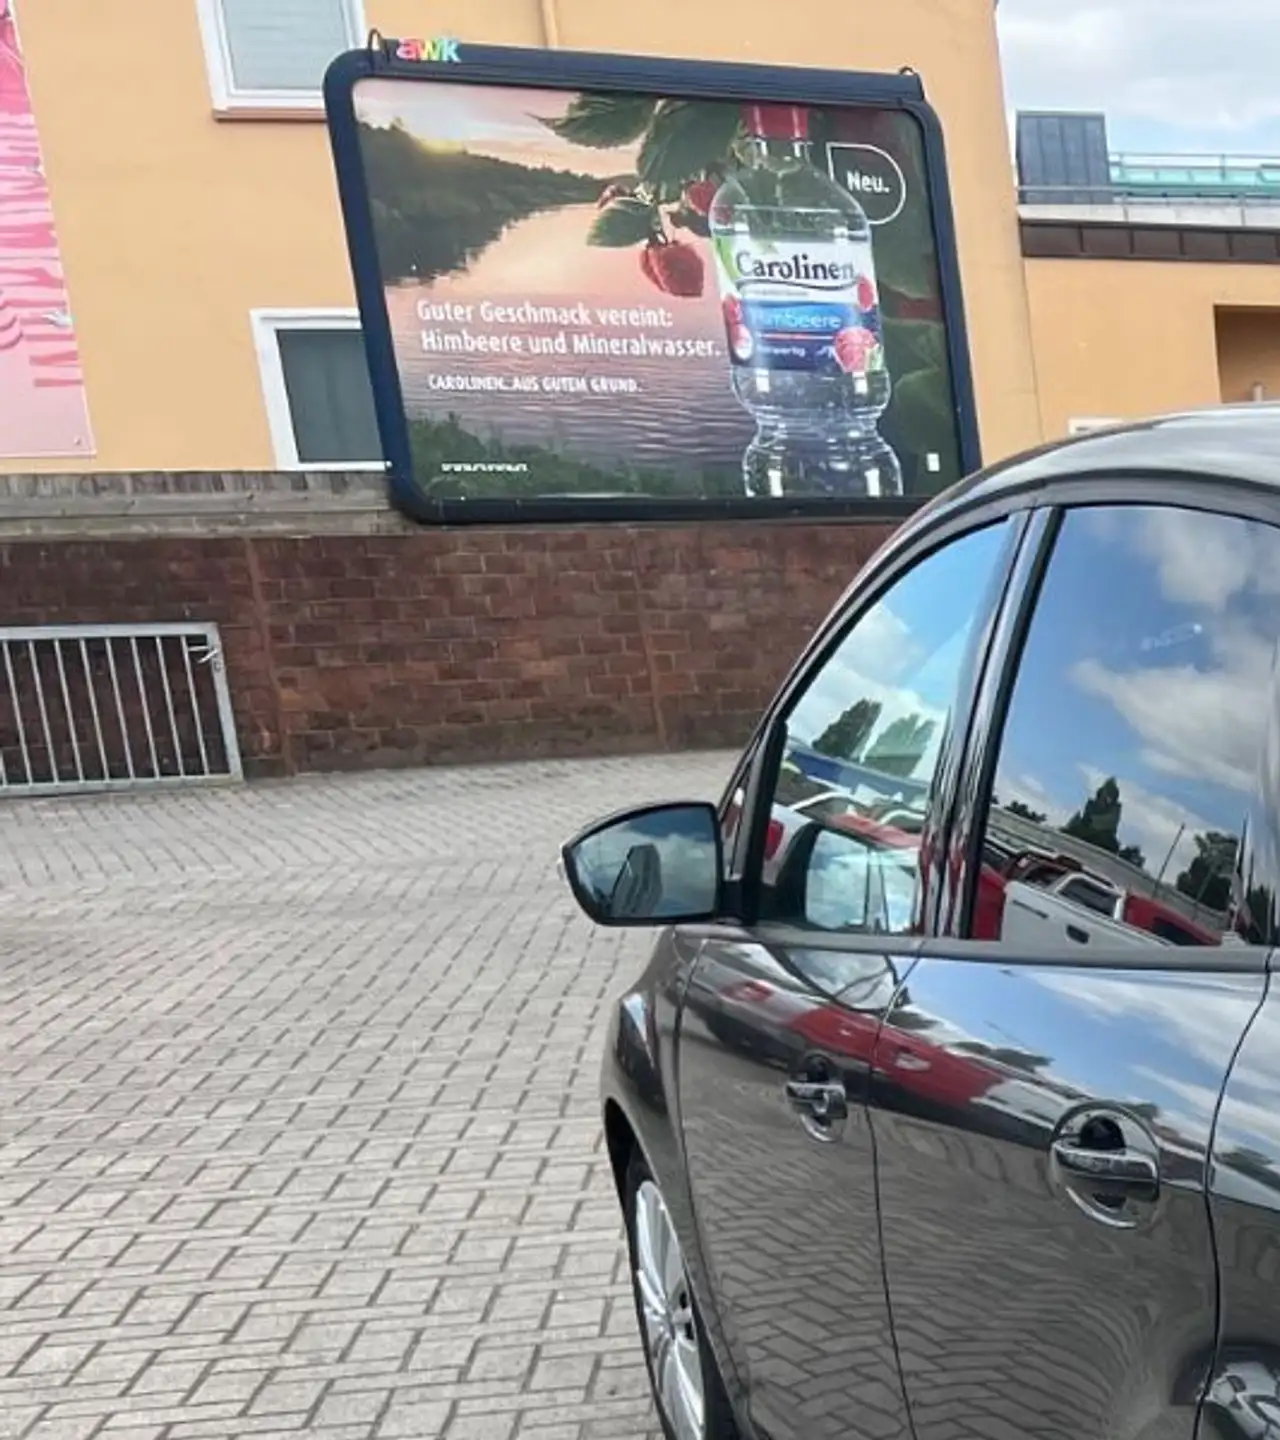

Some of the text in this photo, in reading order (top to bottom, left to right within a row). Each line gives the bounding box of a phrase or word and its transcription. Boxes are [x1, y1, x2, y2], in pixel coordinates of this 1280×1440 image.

[396, 37, 461, 62] awk
[847, 170, 890, 193] Neu.
[736, 253, 855, 281] Carolinen
[417, 300, 674, 328] Guter Geschmack vereint:
[421, 330, 722, 357] Himbeere und Mineralwasser.
[513, 377, 538, 392] AUS
[543, 377, 588, 392] GUTEM
[591, 377, 643, 393] GRUND.
